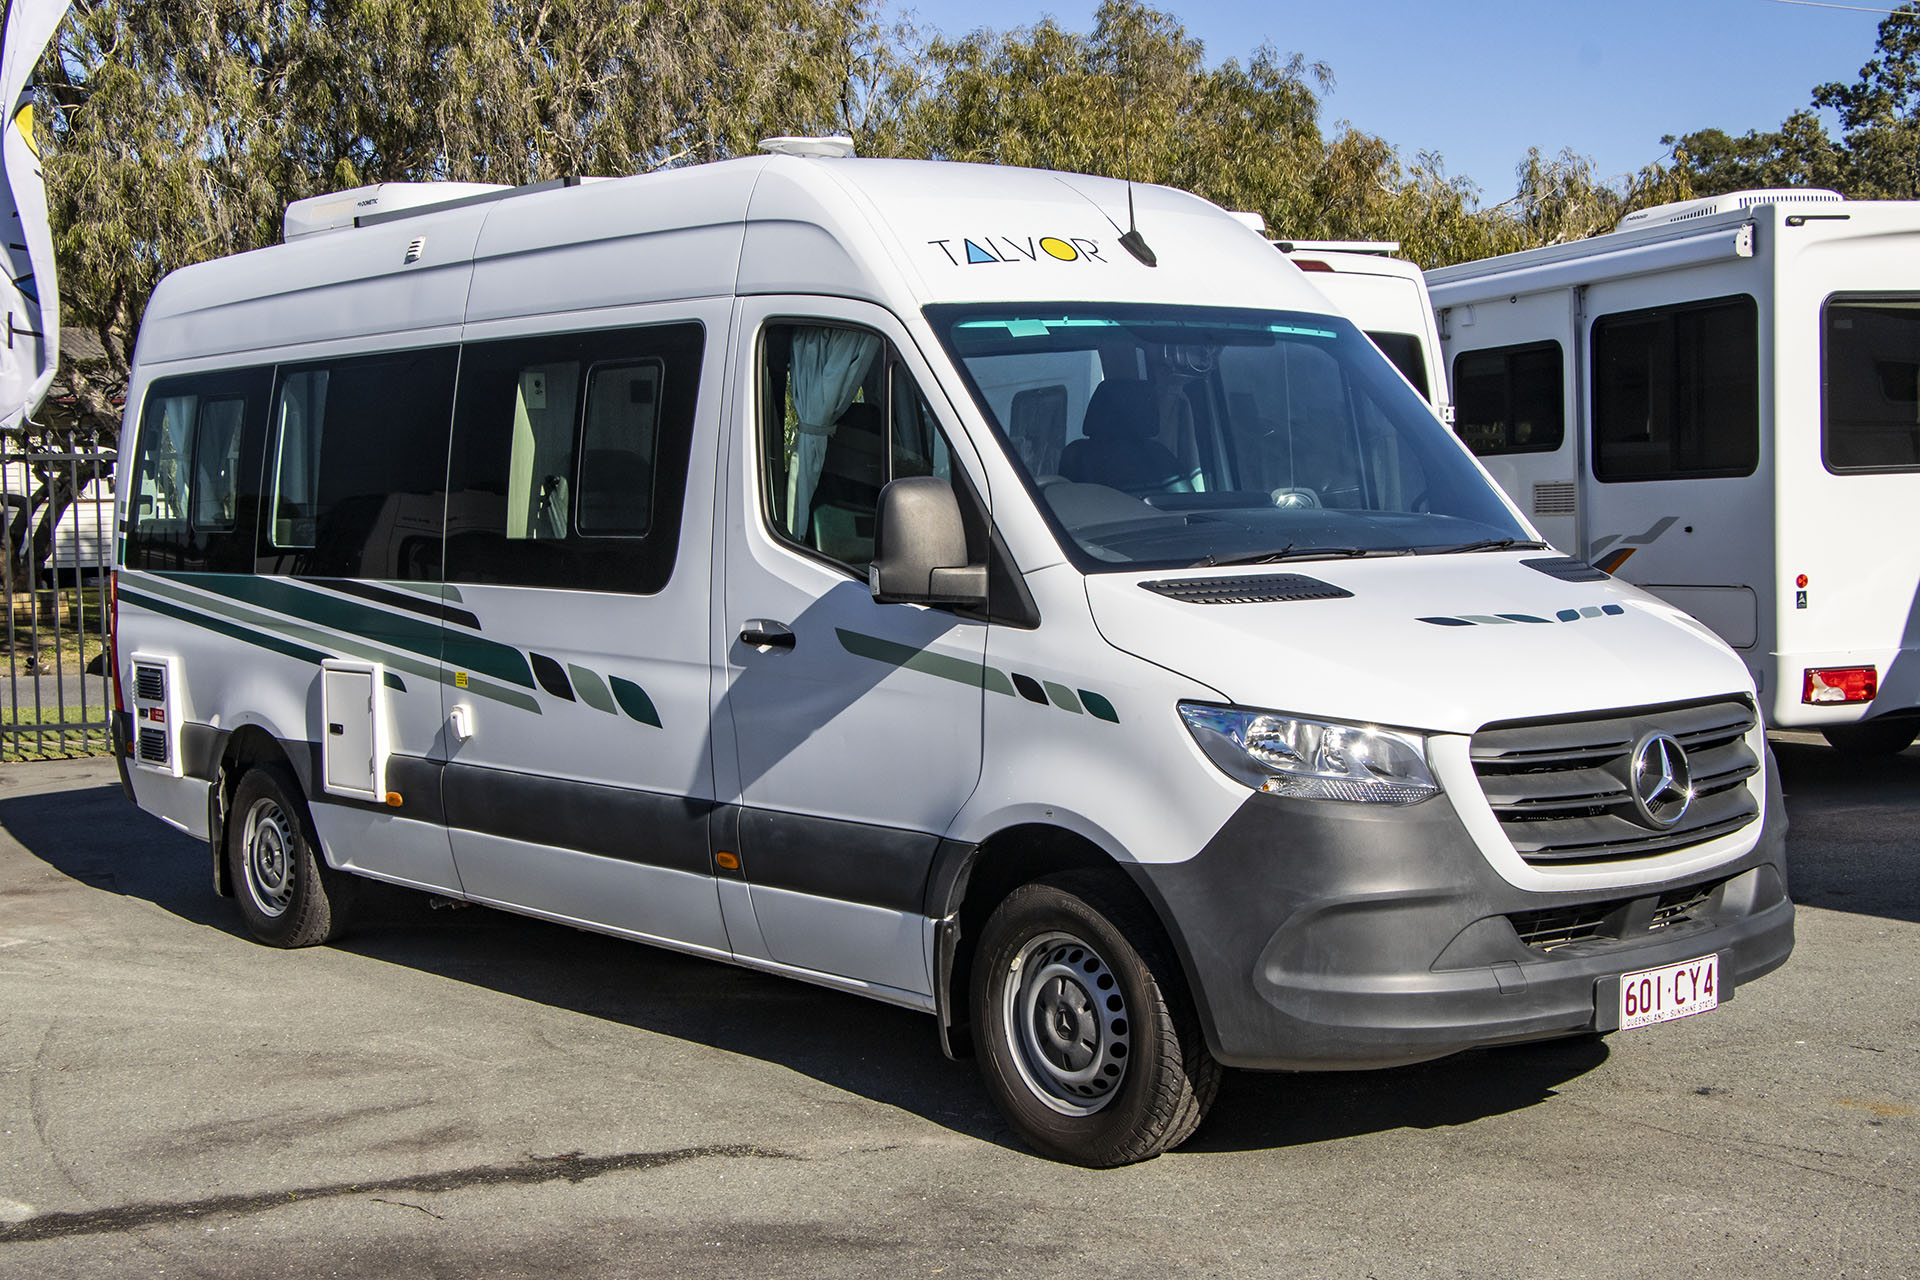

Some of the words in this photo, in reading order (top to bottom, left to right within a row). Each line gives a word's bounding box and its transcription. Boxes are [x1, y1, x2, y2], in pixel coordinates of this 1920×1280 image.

[927, 236, 1108, 266] TALVOR
[1627, 1011, 1665, 1027] QUEENSLAND
[1670, 1004, 1697, 1017] SUNSHINE
[1698, 999, 1715, 1010] STATE
